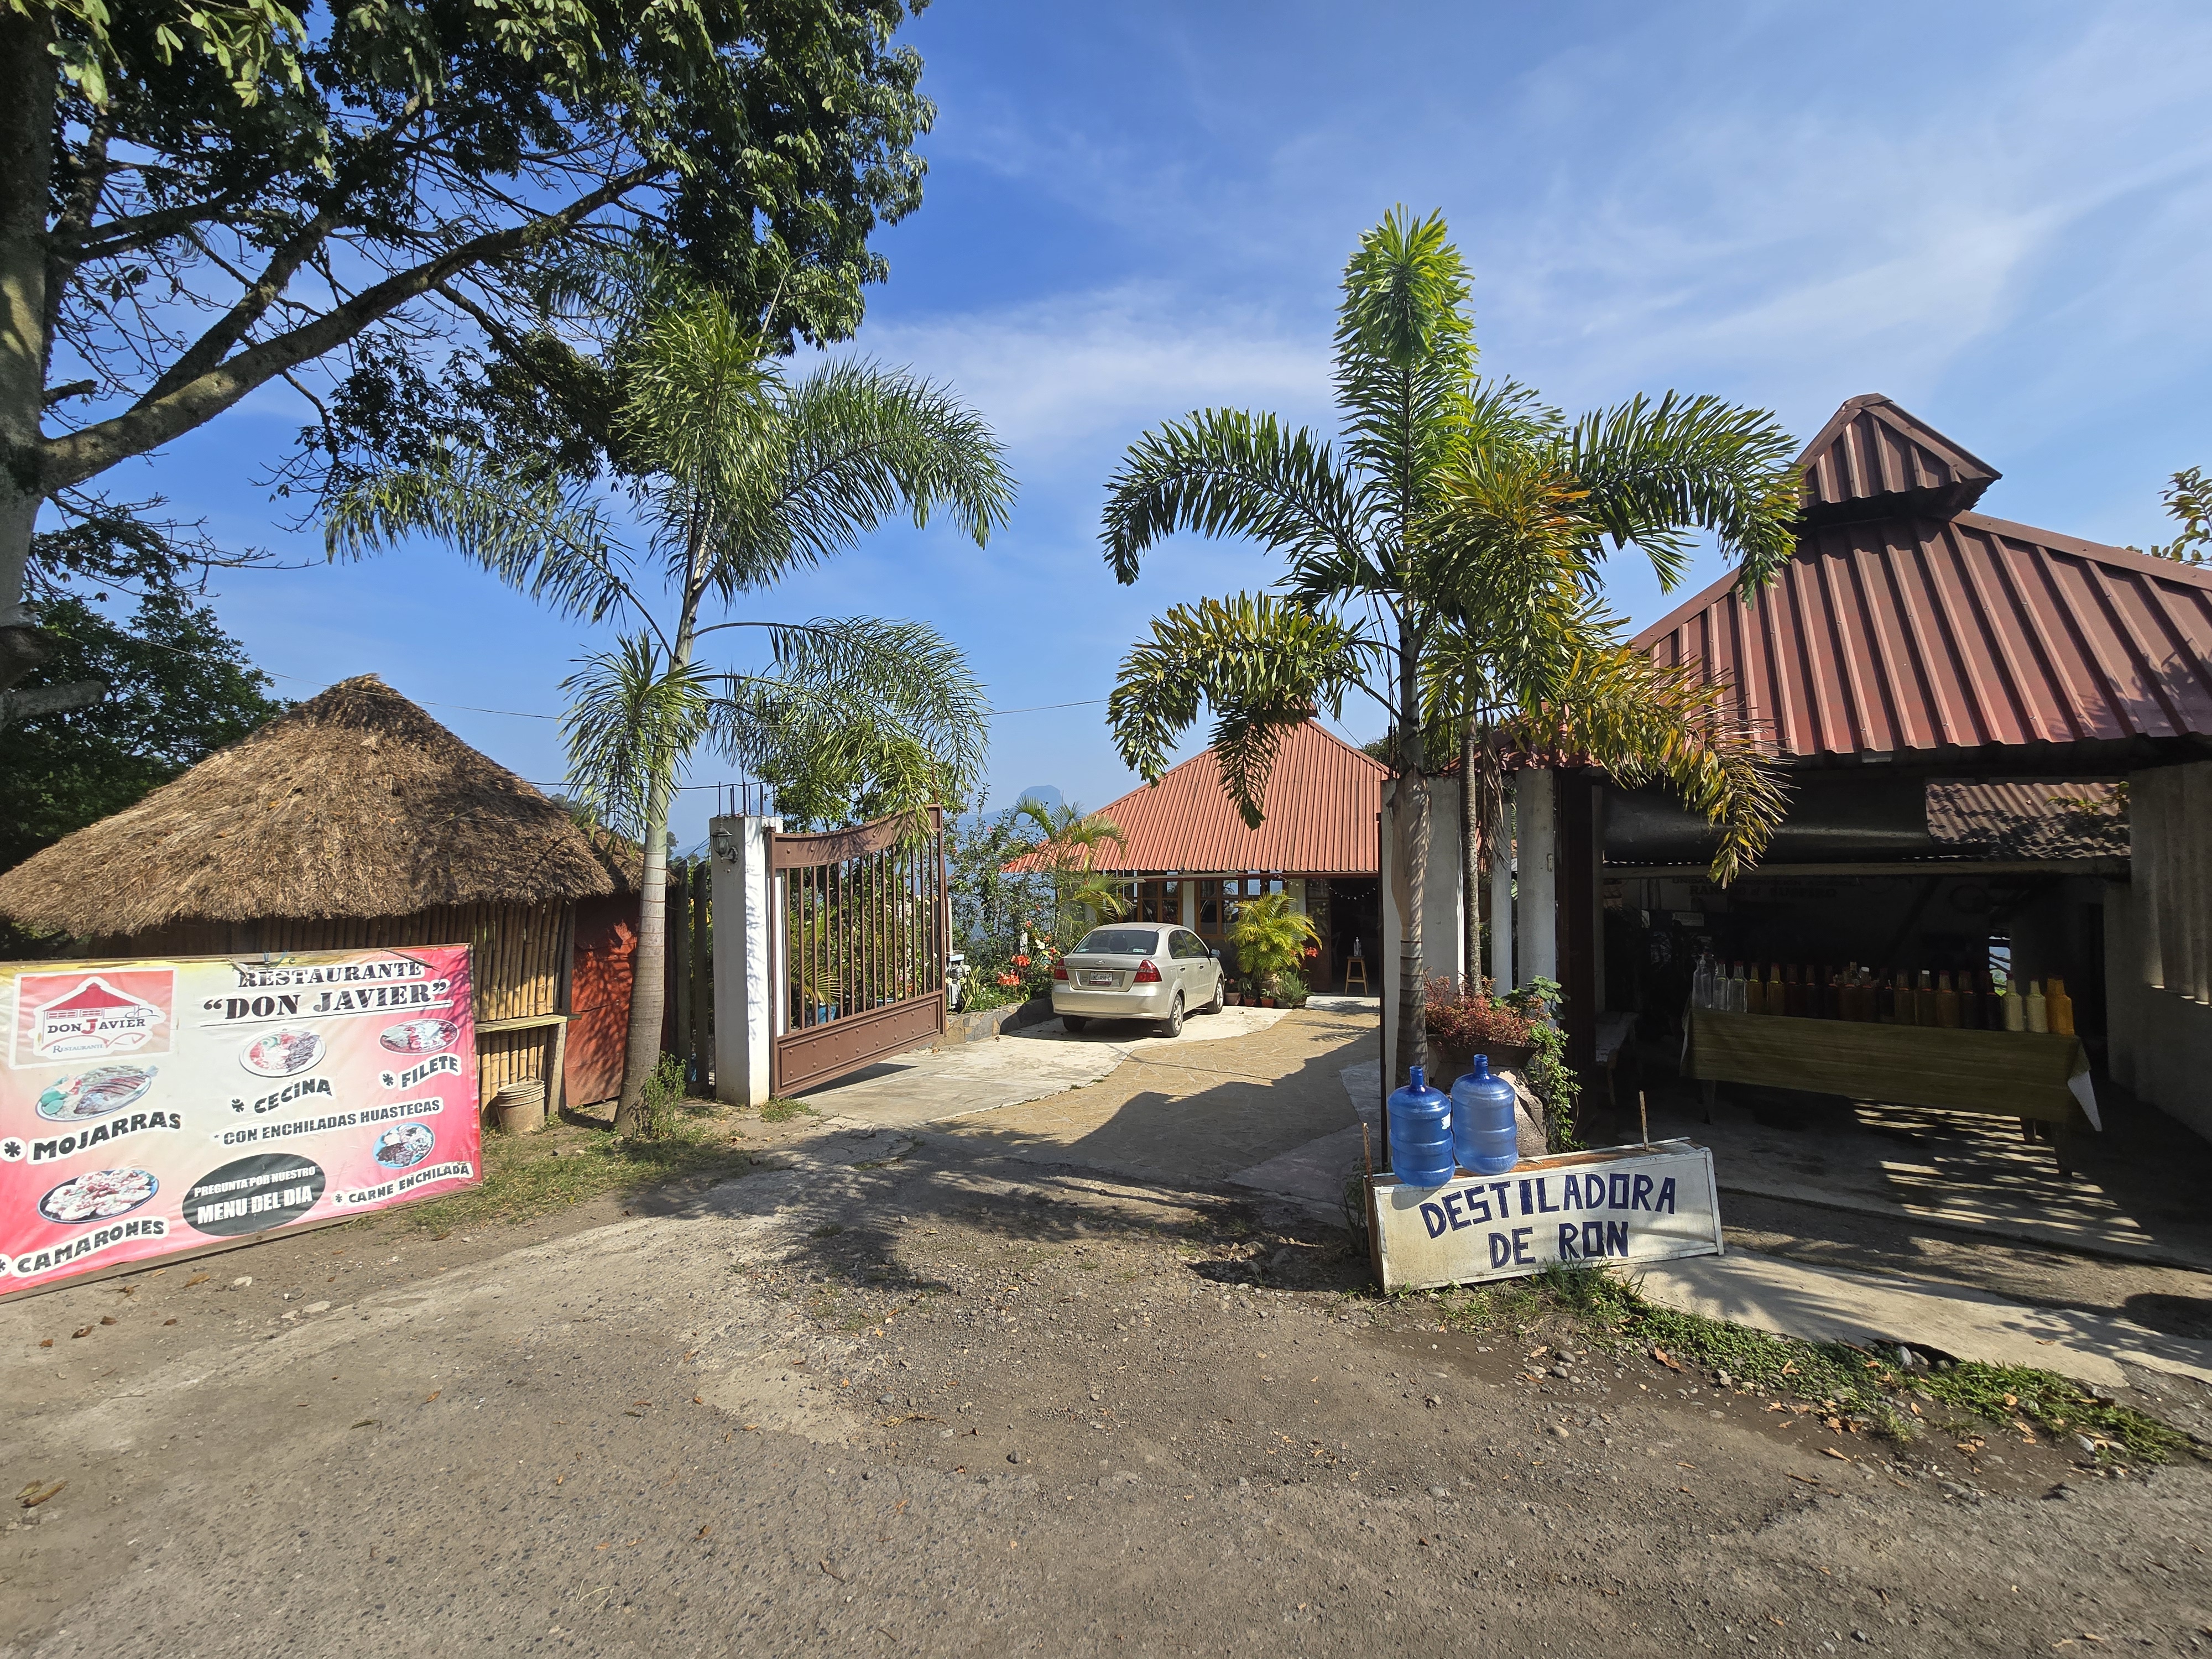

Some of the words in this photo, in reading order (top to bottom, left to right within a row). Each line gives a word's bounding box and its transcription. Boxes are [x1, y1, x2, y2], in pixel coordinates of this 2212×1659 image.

[238, 961, 421, 988] RESTAURANTE
[401, 1056, 458, 1088] FILETE
[254, 1078, 332, 1114] CECINA
[33, 1112, 181, 1160] MOJARRAS
[223, 1128, 258, 1145] CON
[262, 1113, 357, 1139] ENCHILADAS
[360, 1099, 440, 1123] HUASTECAS
[194, 1178, 248, 1197] PREGUNTA
[249, 1175, 270, 1187] POR
[271, 1166, 316, 1183] NUESTRO
[348, 1183, 394, 1203] CARNE
[399, 1164, 469, 1191] ENCHILADA
[197, 1198, 248, 1224] MENU
[251, 1191, 283, 1213] DEL
[284, 1185, 313, 1205] DIA
[1419, 1173, 1676, 1239] DESTILADORA
[17, 1220, 164, 1273] CAMARONES
[1489, 1227, 1536, 1269] DE
[1558, 1220, 1629, 1260] RON
